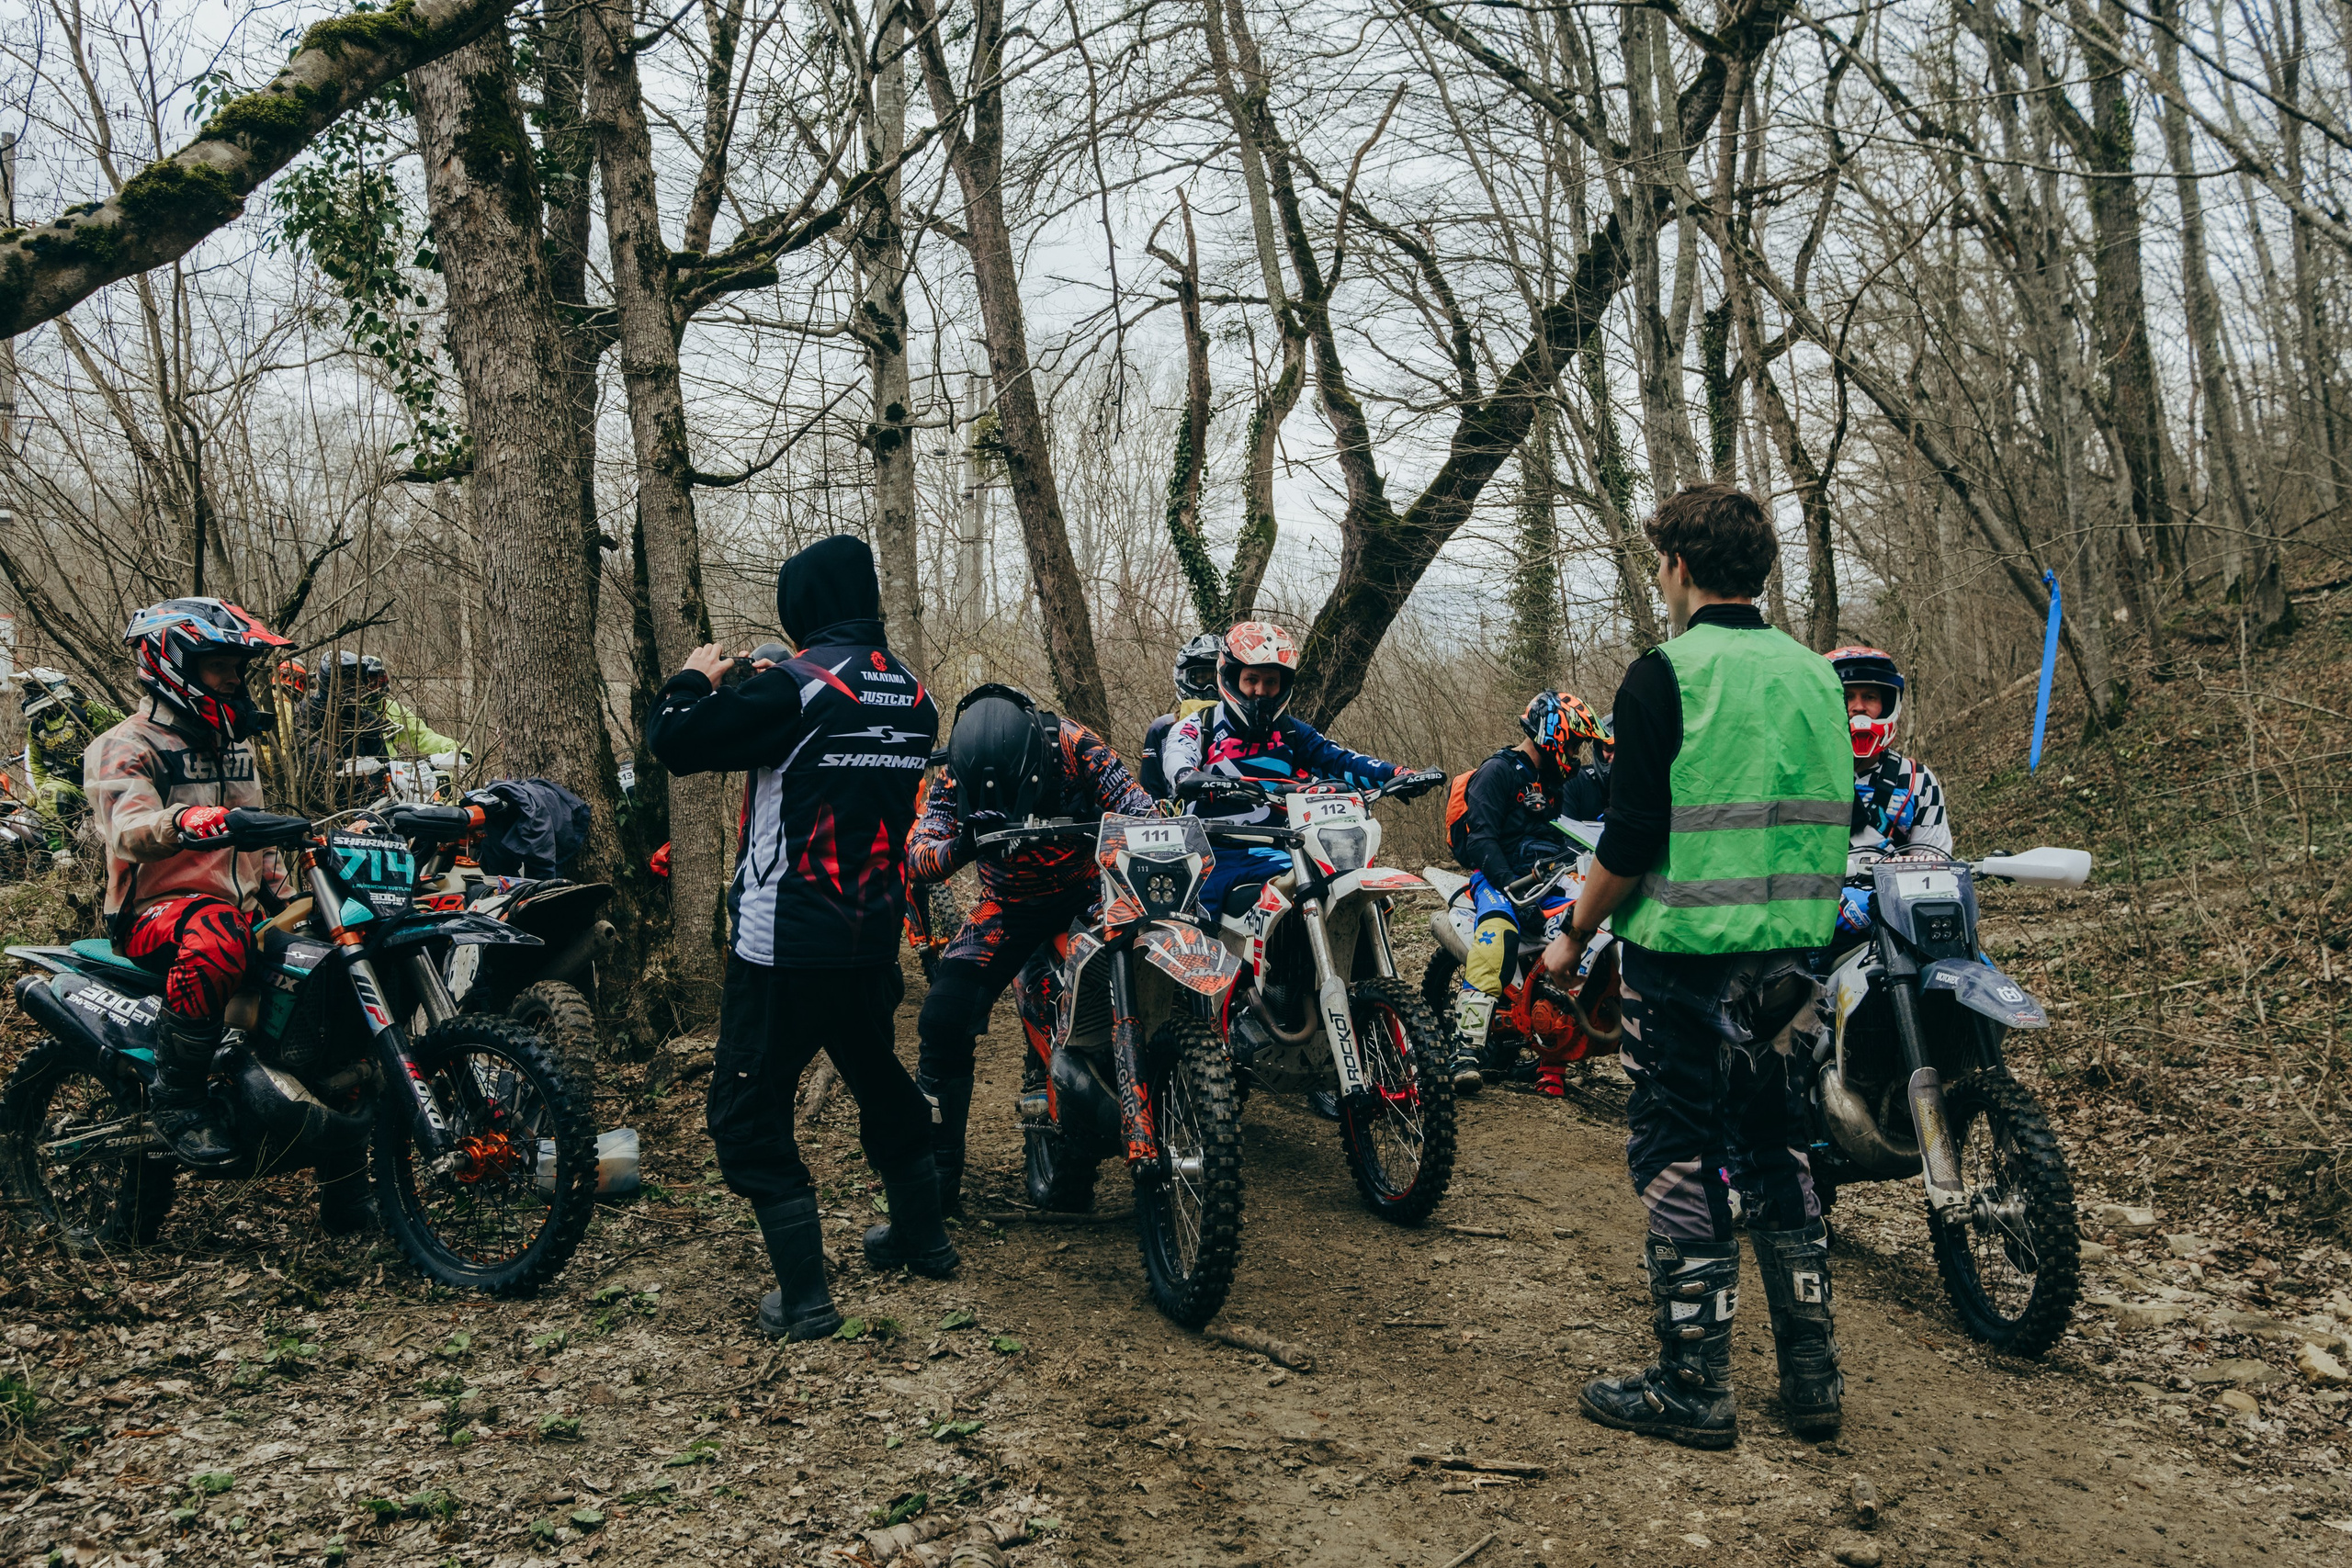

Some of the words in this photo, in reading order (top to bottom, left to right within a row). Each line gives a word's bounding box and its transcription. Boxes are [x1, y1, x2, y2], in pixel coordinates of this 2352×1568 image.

[860, 671, 907, 684] TAKAYAMA
[859, 691, 915, 706] JUSTCAT
[818, 754, 929, 770] SHARMAX
[1320, 804, 1347, 815] 112
[1141, 829, 1170, 842] 111
[334, 836, 408, 851] SHARMAX
[333, 847, 415, 885] 714
[1921, 876, 1930, 889] 1
[1183, 967, 1223, 978] KTM
[1935, 971, 1961, 986] MOTOREX
[65, 993, 107, 1015] EXPERT
[107, 1010, 130, 1027] PRO
[1327, 1007, 1360, 1082] ROCKOT
[1114, 1045, 1136, 1119] X-GRIP
